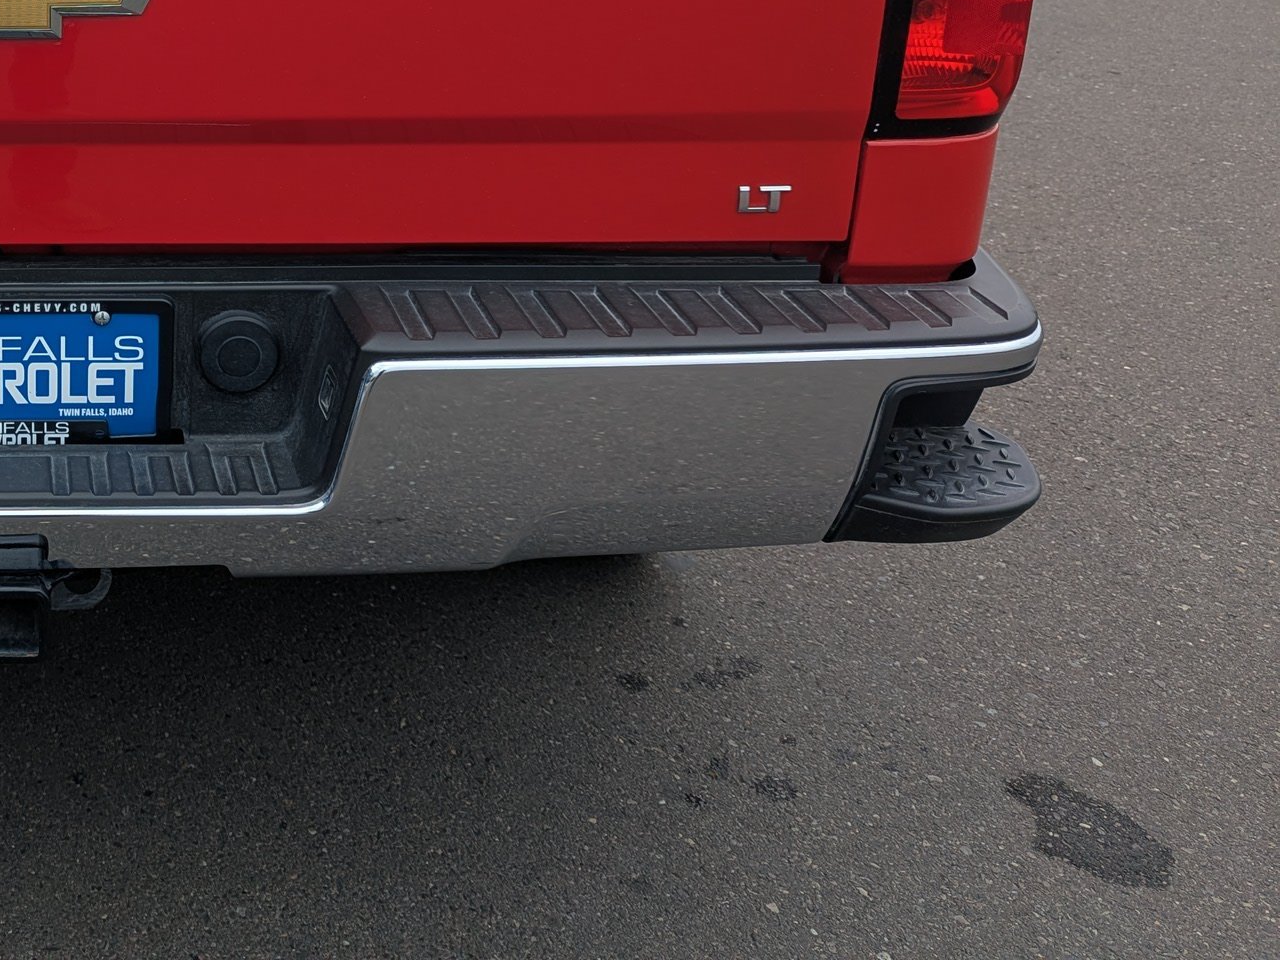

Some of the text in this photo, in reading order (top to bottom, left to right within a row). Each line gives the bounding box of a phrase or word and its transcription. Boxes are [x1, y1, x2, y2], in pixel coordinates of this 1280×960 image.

[738, 185, 792, 213] LT
[58, 407, 134, 417] TWIN FALLS, IDAHO
